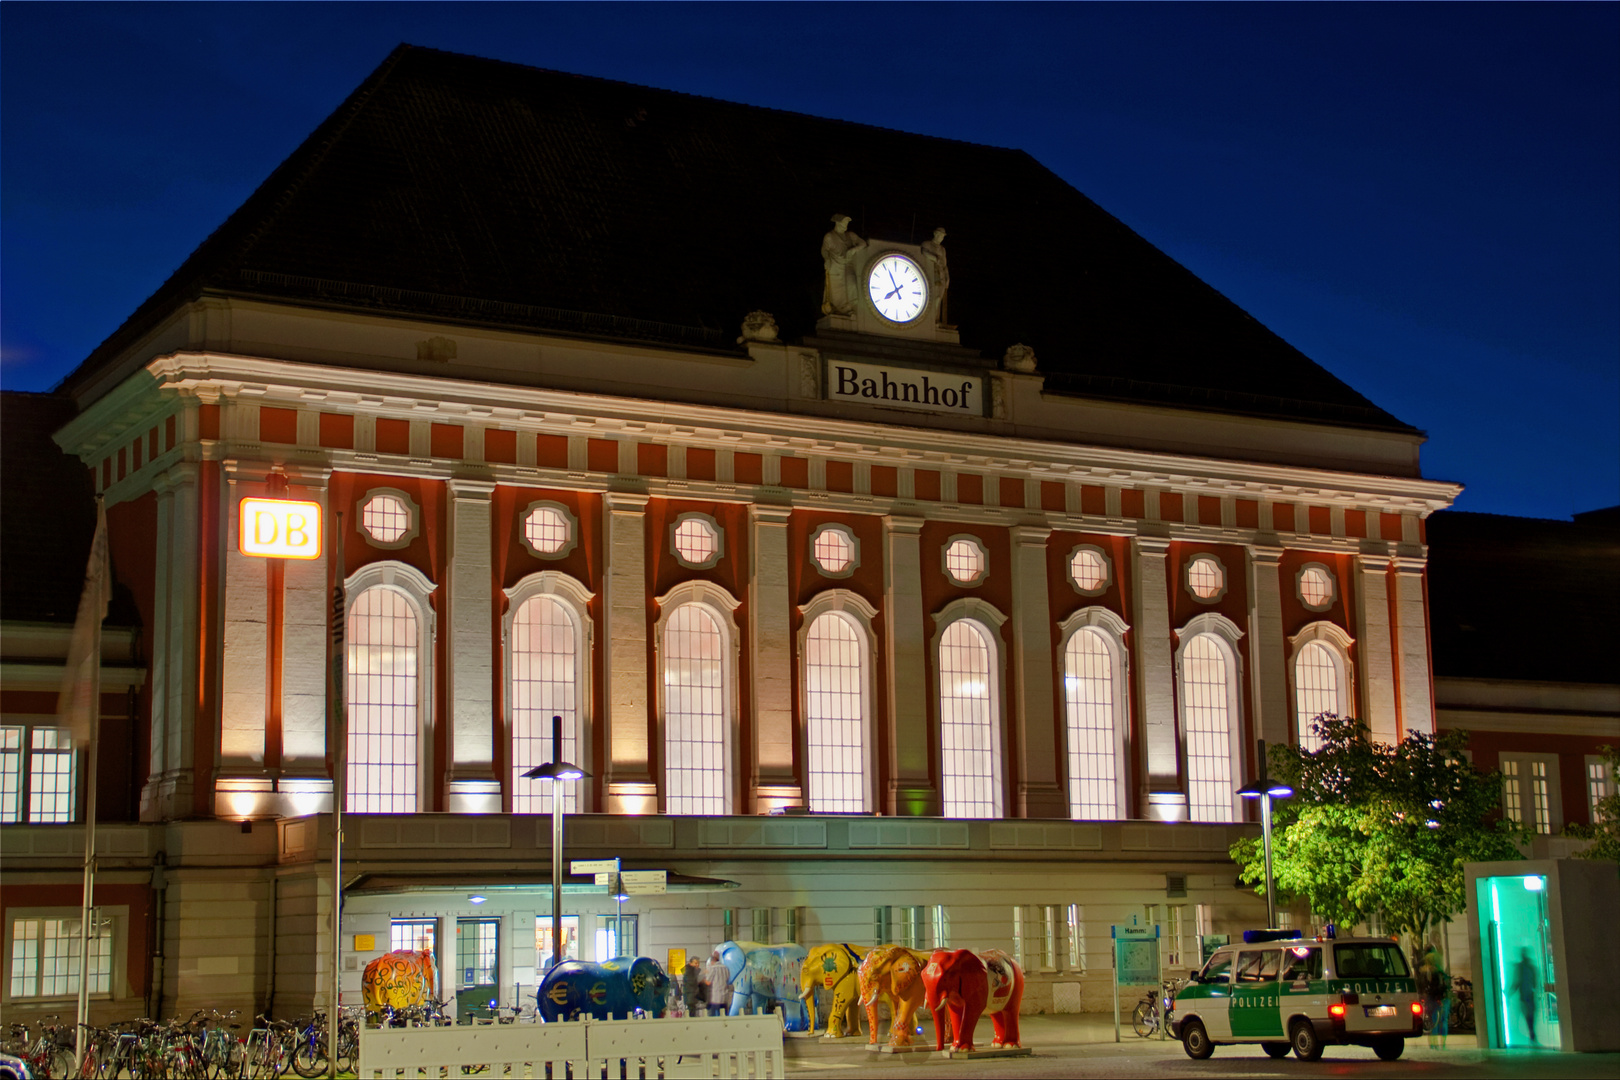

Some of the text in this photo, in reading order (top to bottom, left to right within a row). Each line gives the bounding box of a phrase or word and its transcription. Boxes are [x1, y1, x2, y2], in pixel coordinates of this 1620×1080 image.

[835, 366, 972, 409] Bahnhof
[254, 510, 309, 547] DB
[1345, 982, 1408, 993] POLIZEI
[1232, 996, 1279, 1008] POLIZEI
